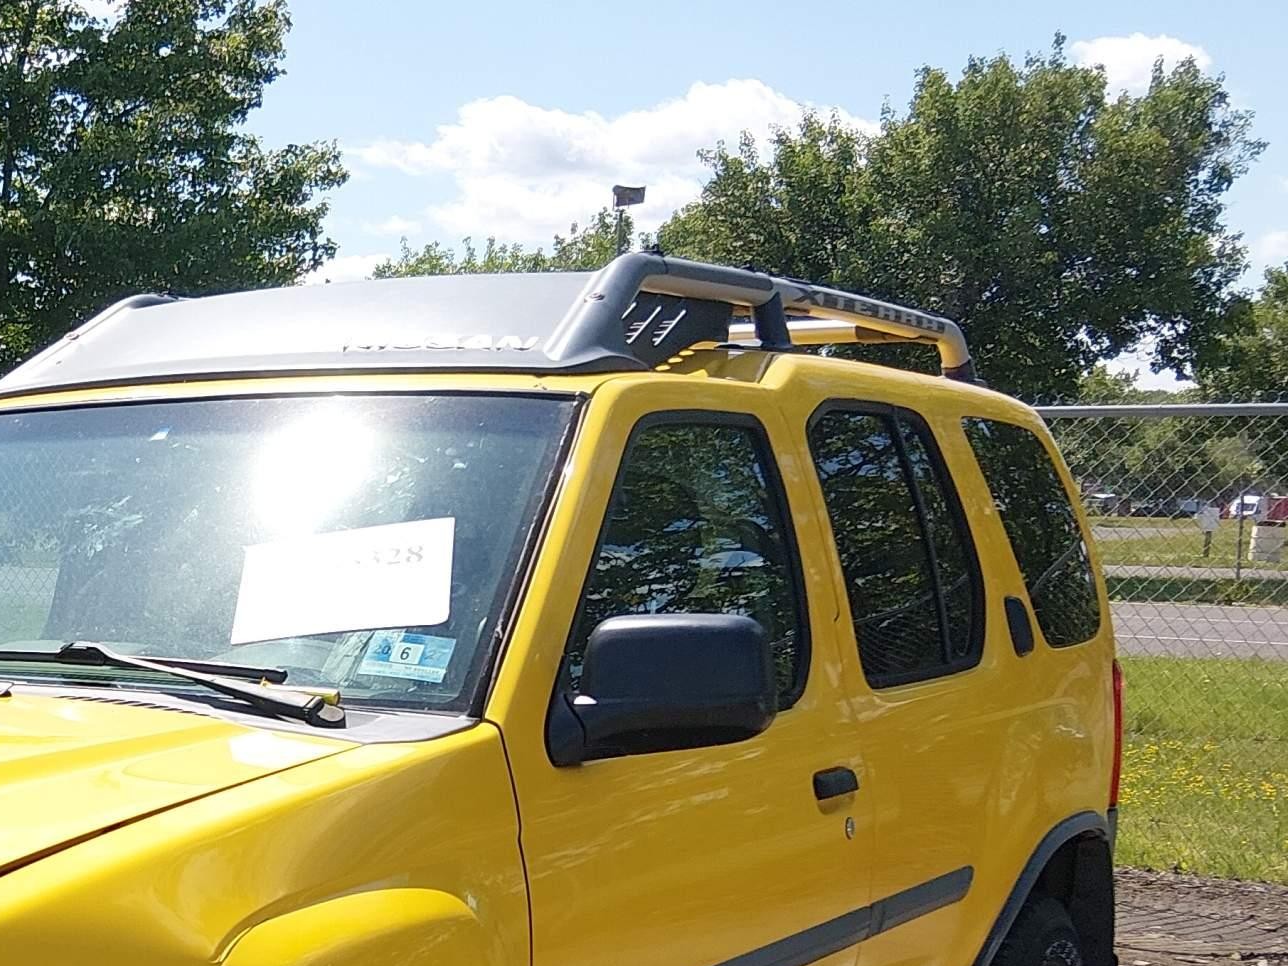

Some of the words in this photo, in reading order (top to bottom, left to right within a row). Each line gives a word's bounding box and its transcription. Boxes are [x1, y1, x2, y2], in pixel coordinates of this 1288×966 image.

[792, 287, 946, 335] XTERRA
[342, 335, 539, 352] SAN
[400, 646, 412, 660] 6
